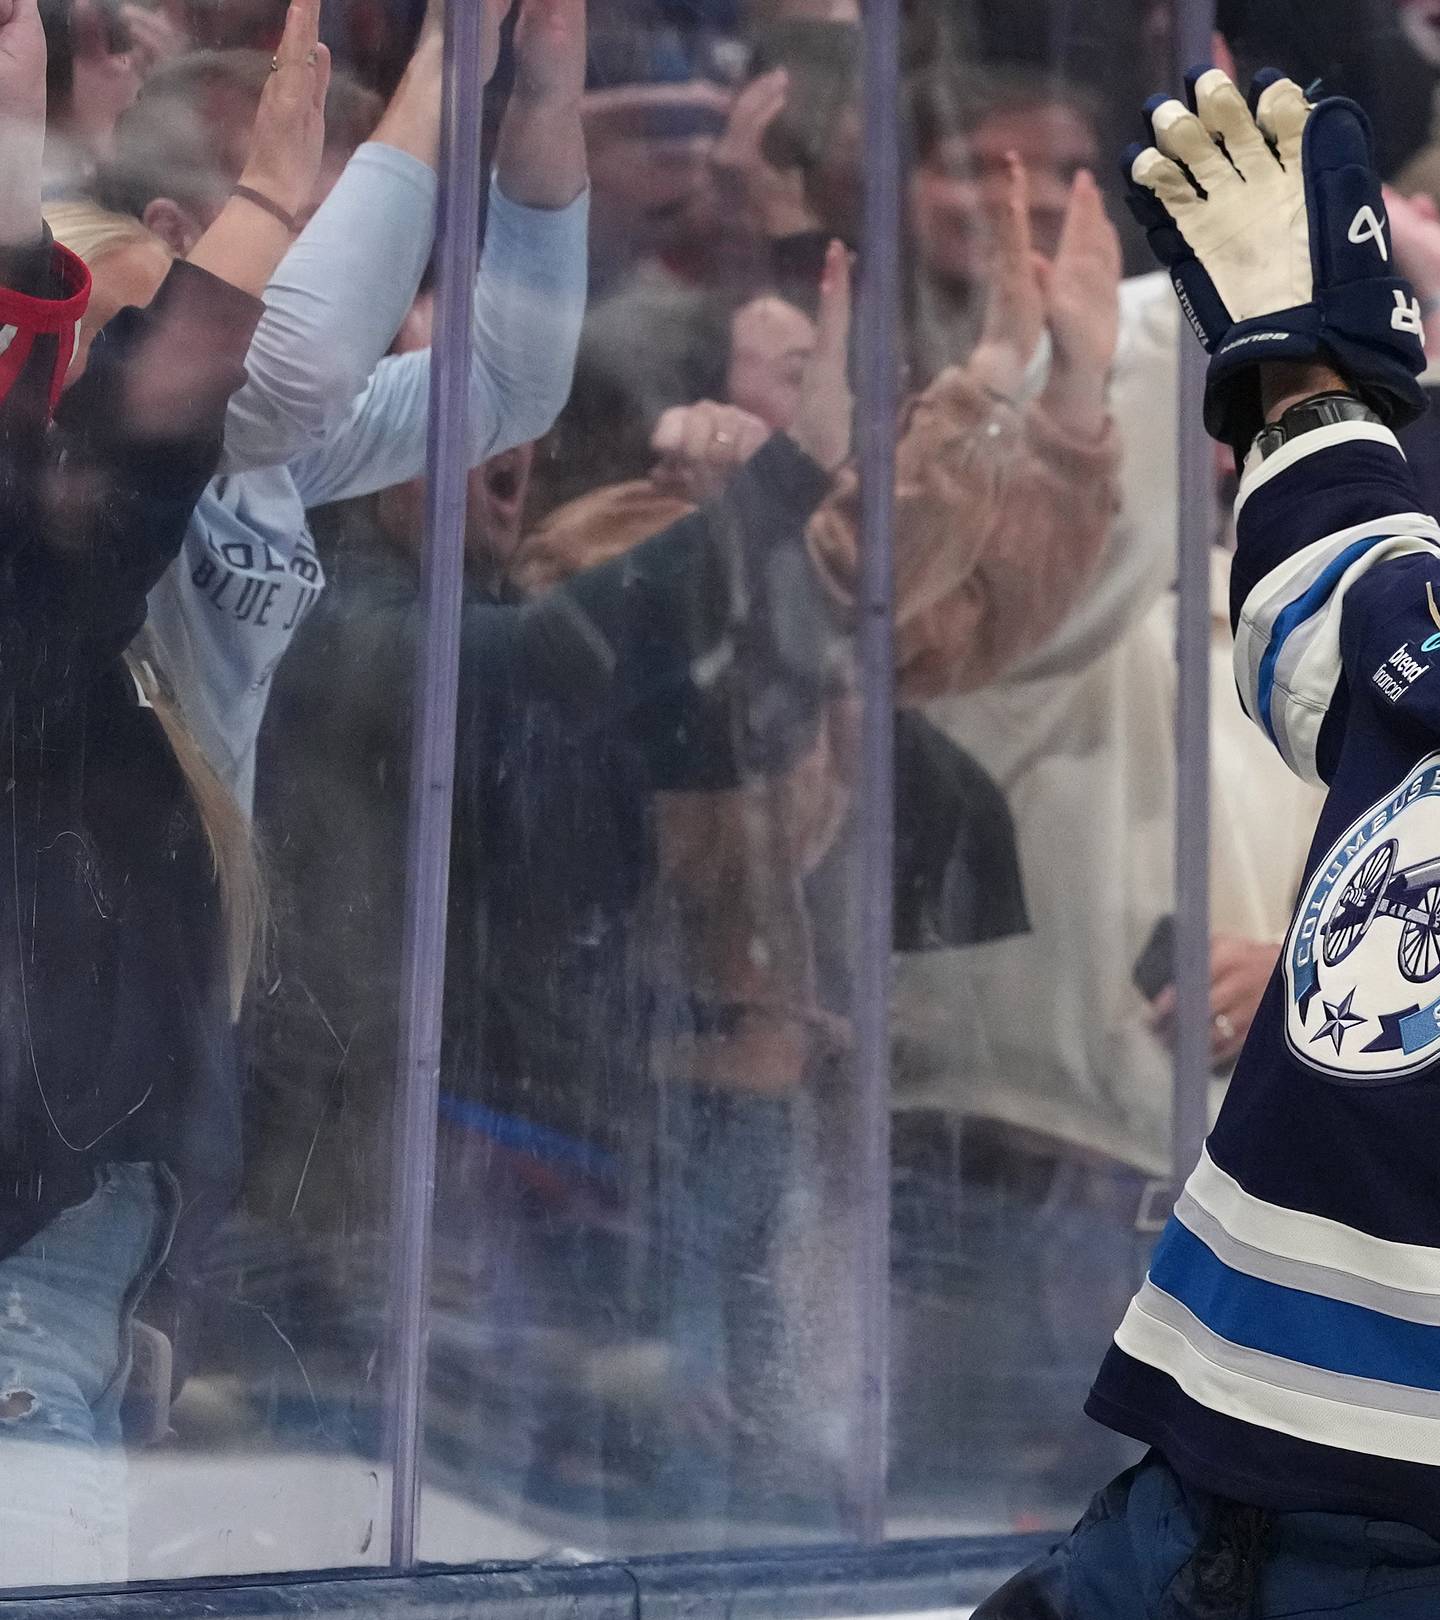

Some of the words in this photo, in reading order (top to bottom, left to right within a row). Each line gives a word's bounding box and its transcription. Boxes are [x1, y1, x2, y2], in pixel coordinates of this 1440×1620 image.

[1220, 332, 1289, 355] BAUER
[192, 559, 281, 627] BLUE
[1372, 664, 1409, 702] financial
[1388, 643, 1430, 683] bread
[1296, 776, 1423, 967] COLUMBUS
